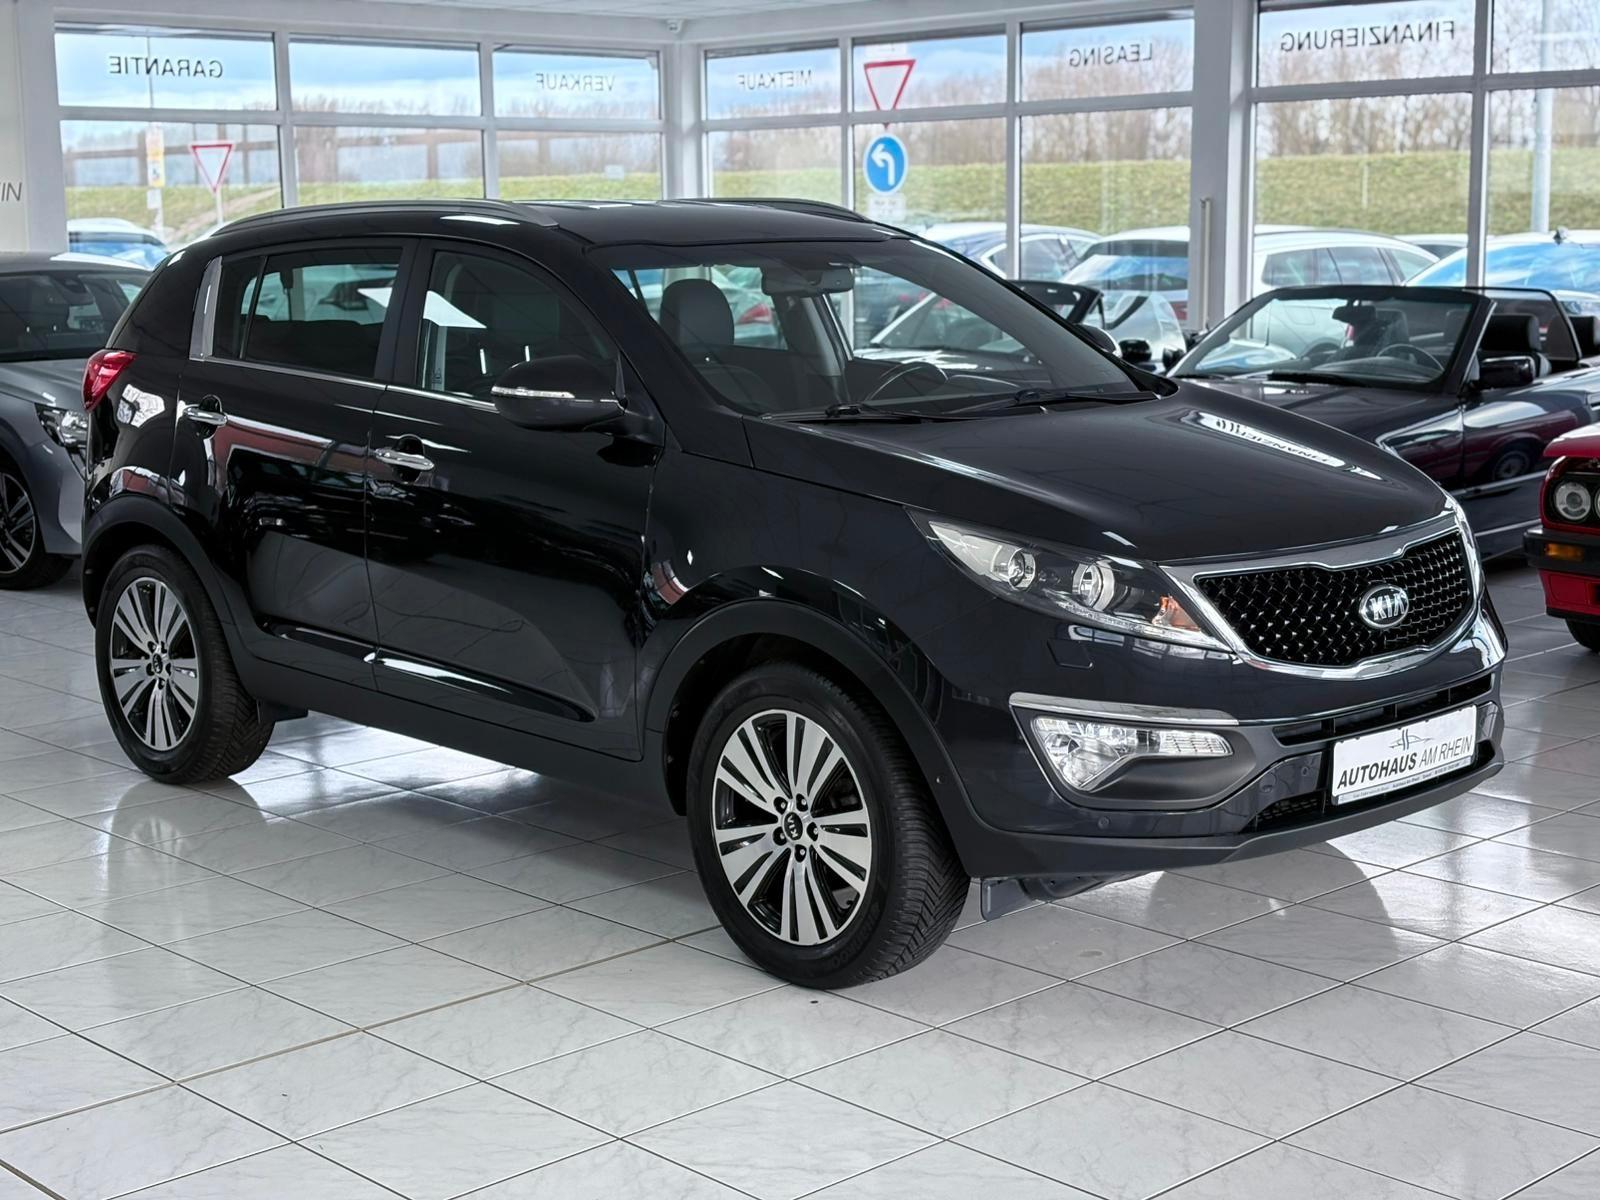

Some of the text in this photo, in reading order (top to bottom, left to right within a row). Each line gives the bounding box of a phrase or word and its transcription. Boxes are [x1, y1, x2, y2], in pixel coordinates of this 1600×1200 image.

[0, 181, 22, 202] IN
[1369, 593, 1405, 621] KIA
[1337, 752, 1417, 789] AUTOHAUS
[1419, 745, 1439, 769] AM
[1439, 735, 1473, 760] RHEIN
